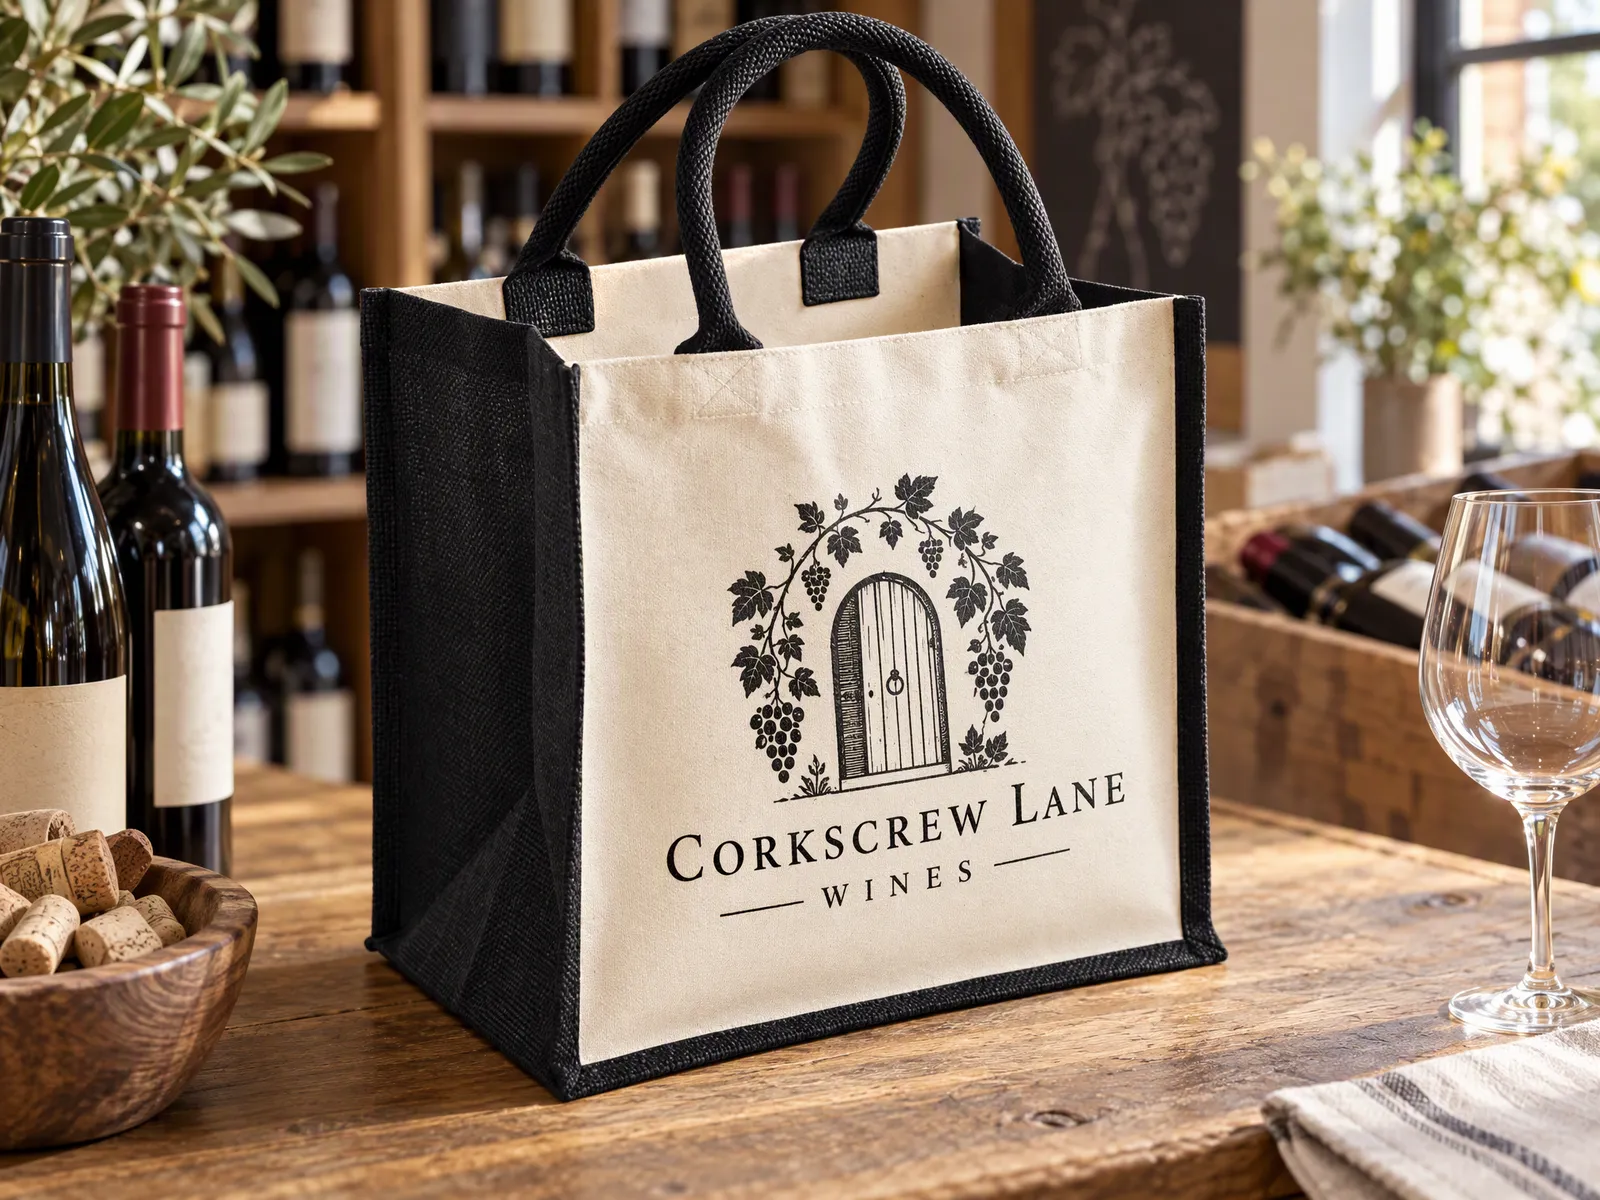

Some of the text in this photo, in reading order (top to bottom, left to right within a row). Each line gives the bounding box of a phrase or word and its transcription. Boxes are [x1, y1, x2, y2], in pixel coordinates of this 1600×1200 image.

[666, 771, 1127, 882] CORKSCREW LANE
[820, 859, 973, 909] WINES
